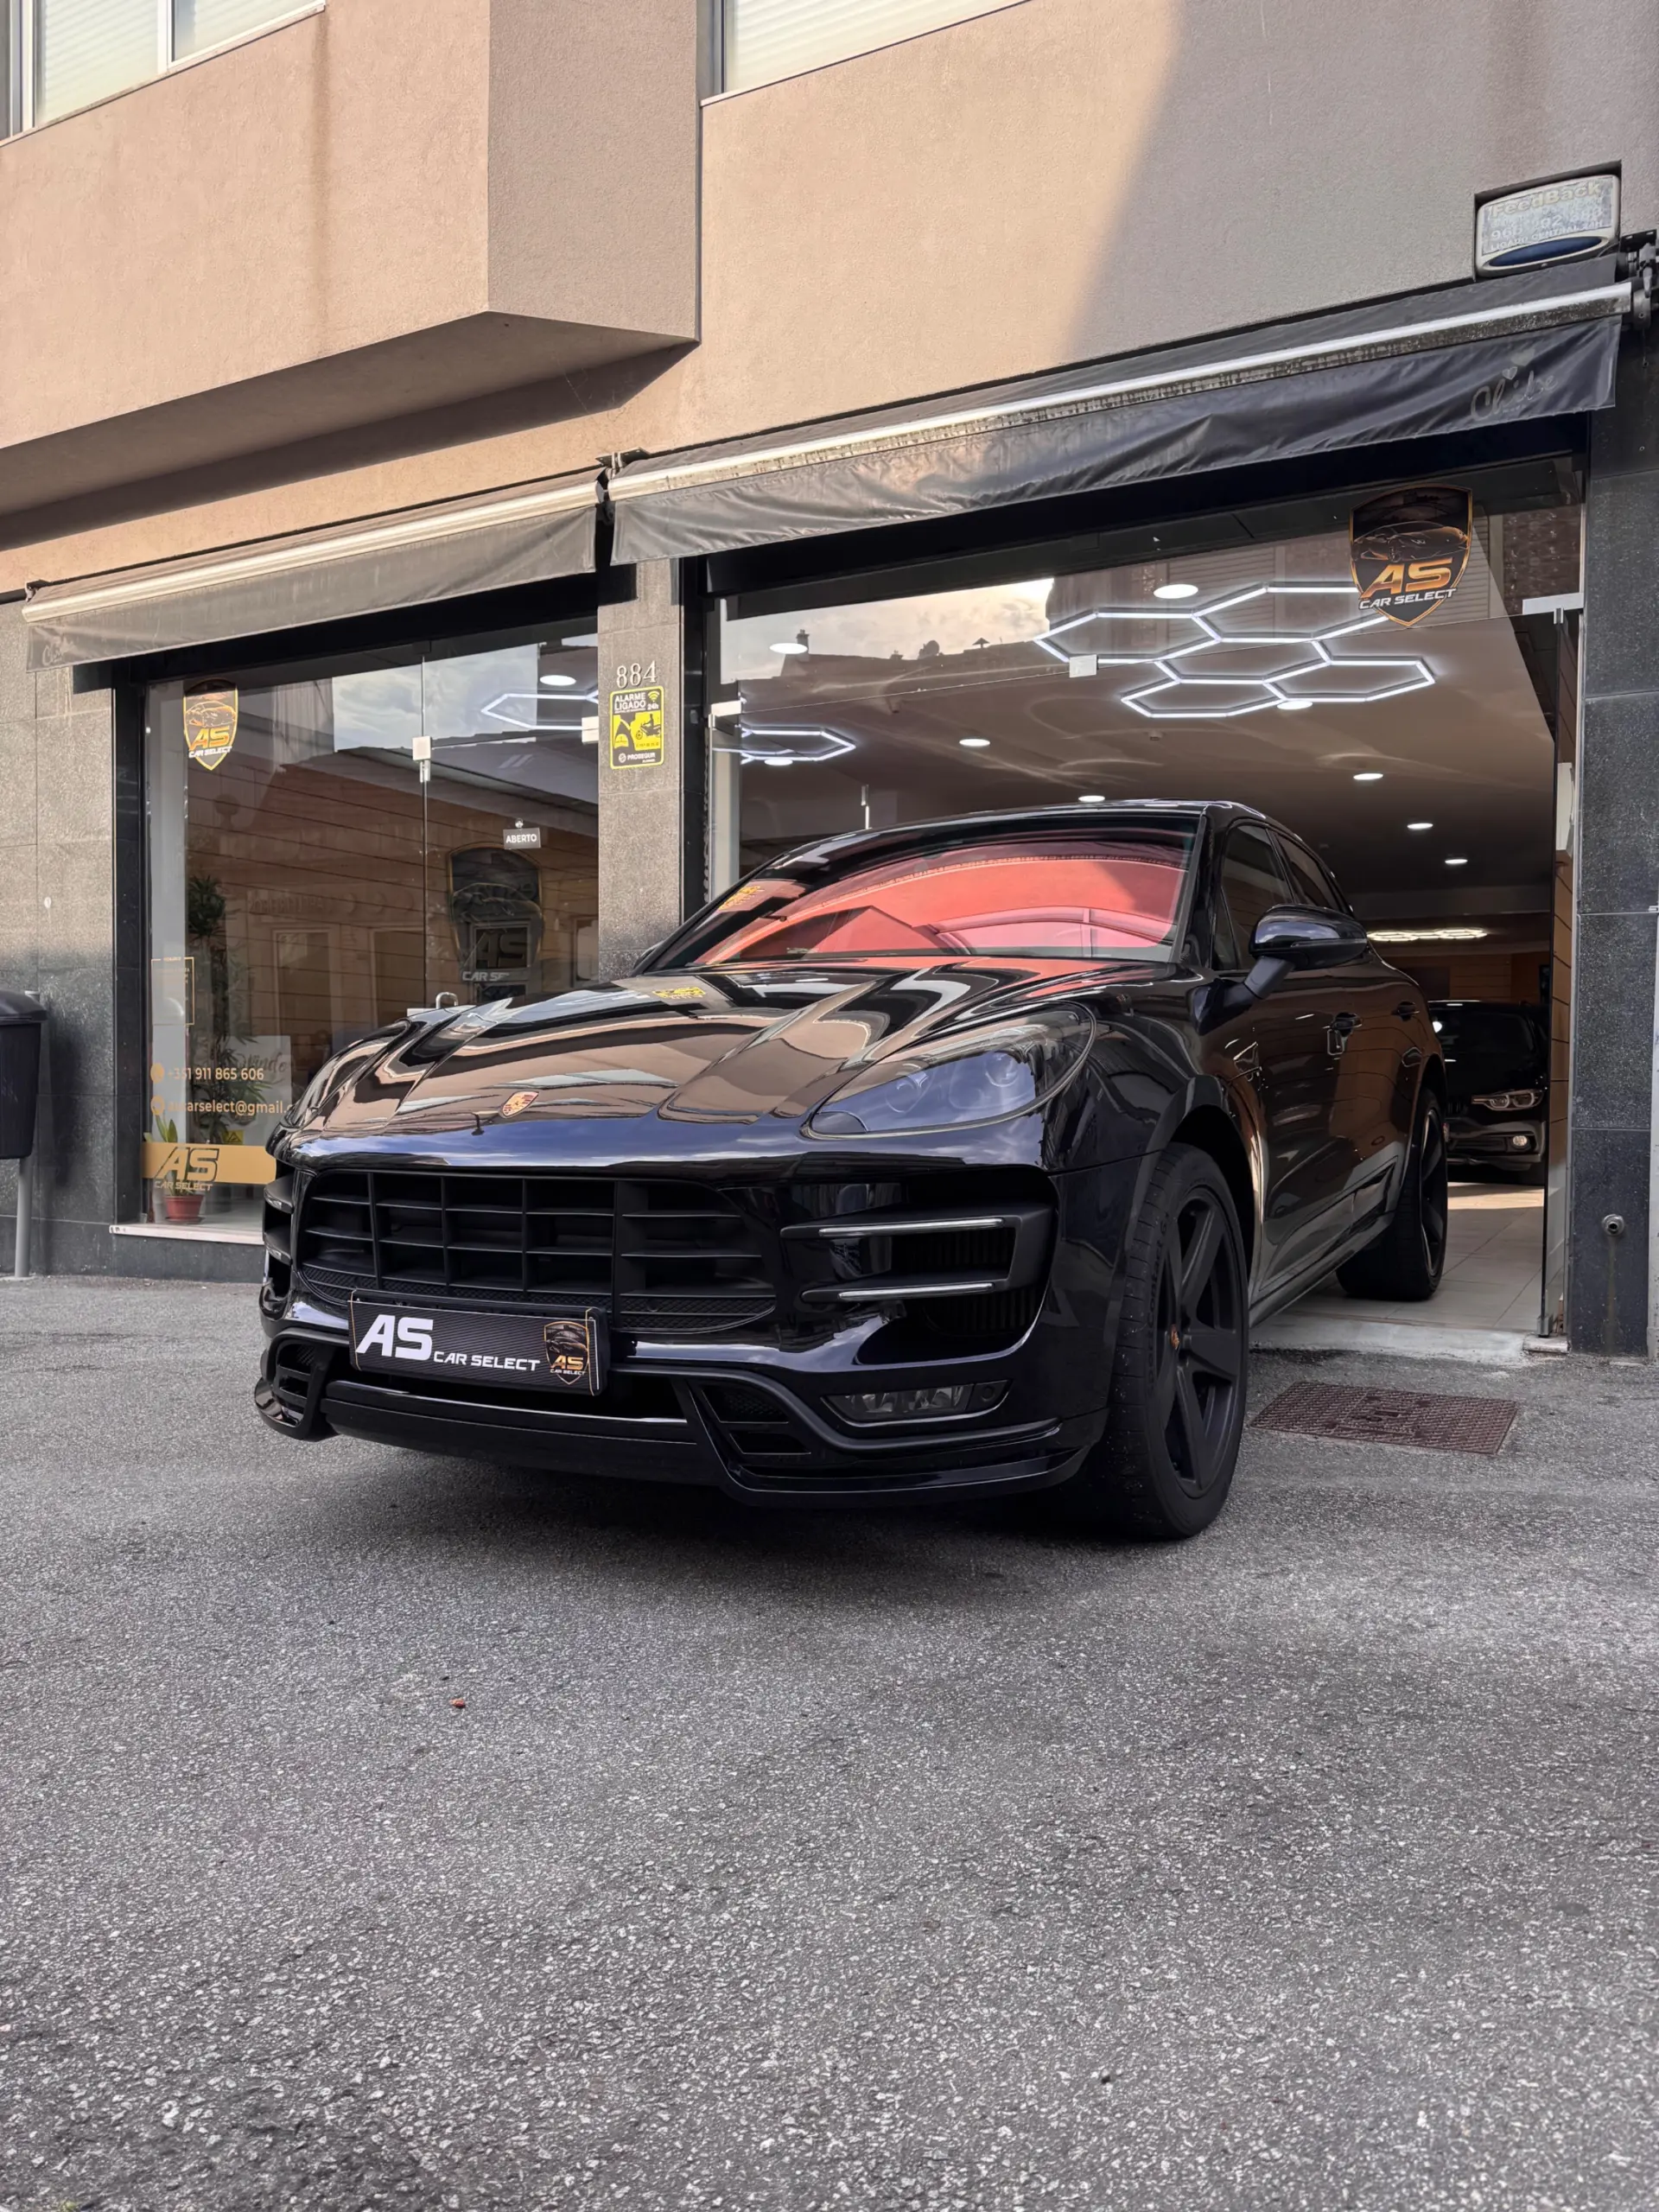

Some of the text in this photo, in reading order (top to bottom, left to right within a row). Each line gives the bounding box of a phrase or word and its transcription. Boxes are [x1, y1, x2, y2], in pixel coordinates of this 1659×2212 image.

[1491, 179, 1601, 218] FeedBack
[1360, 557, 1452, 599] AS
[1359, 588, 1457, 609] CAR SELECT
[616, 660, 657, 689] 884
[614, 692, 646, 703] ALARME
[614, 700, 646, 711] LIGADO
[188, 726, 230, 751] AS
[204, 746, 232, 755] SELECT
[505, 833, 537, 843] ABERTO
[195, 1067, 212, 1080] 911
[215, 1067, 237, 1080] 865
[241, 1067, 264, 1080] 606
[155, 1147, 219, 1182] AS
[155, 1180, 213, 1191] CAR SELECT
[355, 1314, 434, 1360] AS
[433, 1351, 540, 1371] CAR SELECT
[550, 1355, 584, 1370] AS
